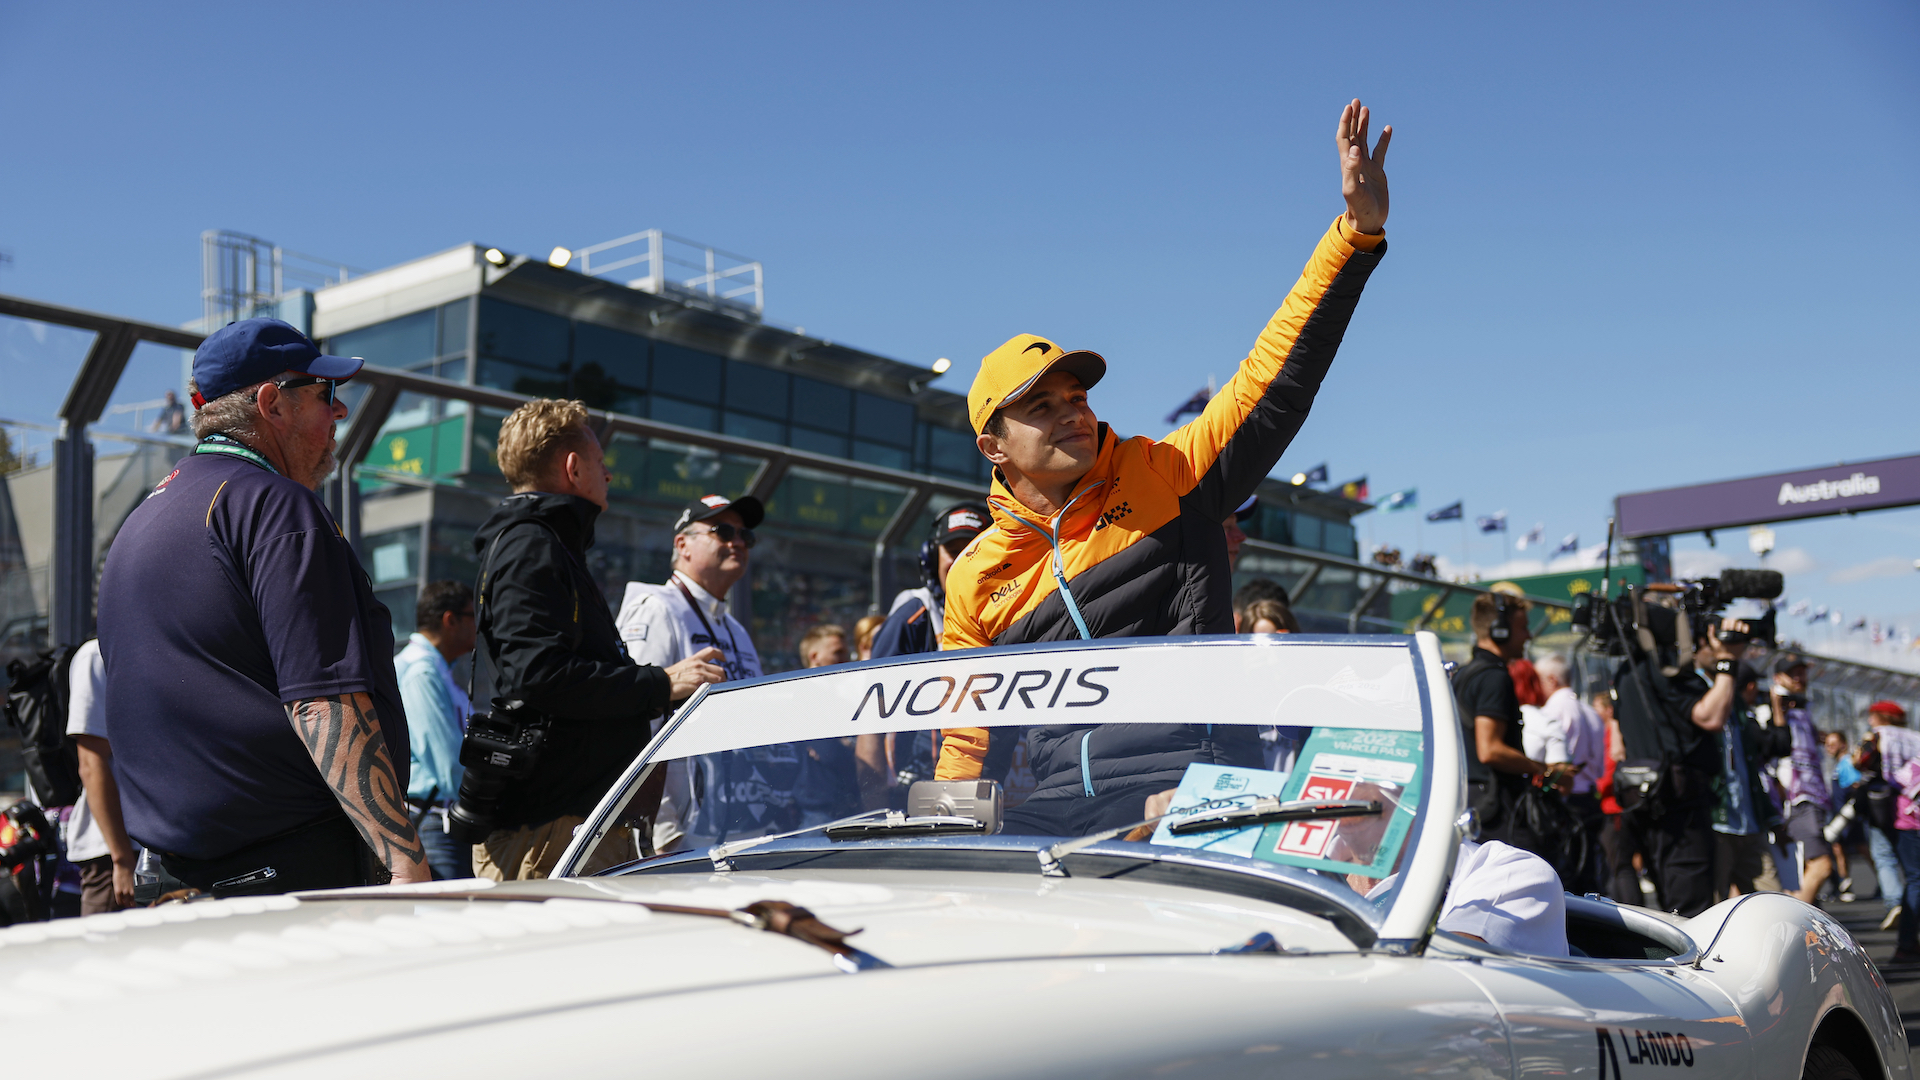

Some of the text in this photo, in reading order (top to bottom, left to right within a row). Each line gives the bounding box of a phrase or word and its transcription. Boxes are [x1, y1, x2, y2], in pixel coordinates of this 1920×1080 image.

[1777, 472, 1881, 506] Australia
[976, 567, 1003, 585] android
[989, 579, 1021, 603] DELL
[993, 588, 1025, 609] Technologies
[851, 666, 1120, 722] NORRIS
[1333, 740, 1411, 759] VEHICLE PASS
[1352, 730, 1398, 747] 2023
[1297, 822, 1324, 846] T
[1618, 1028, 1694, 1068] LANDO
